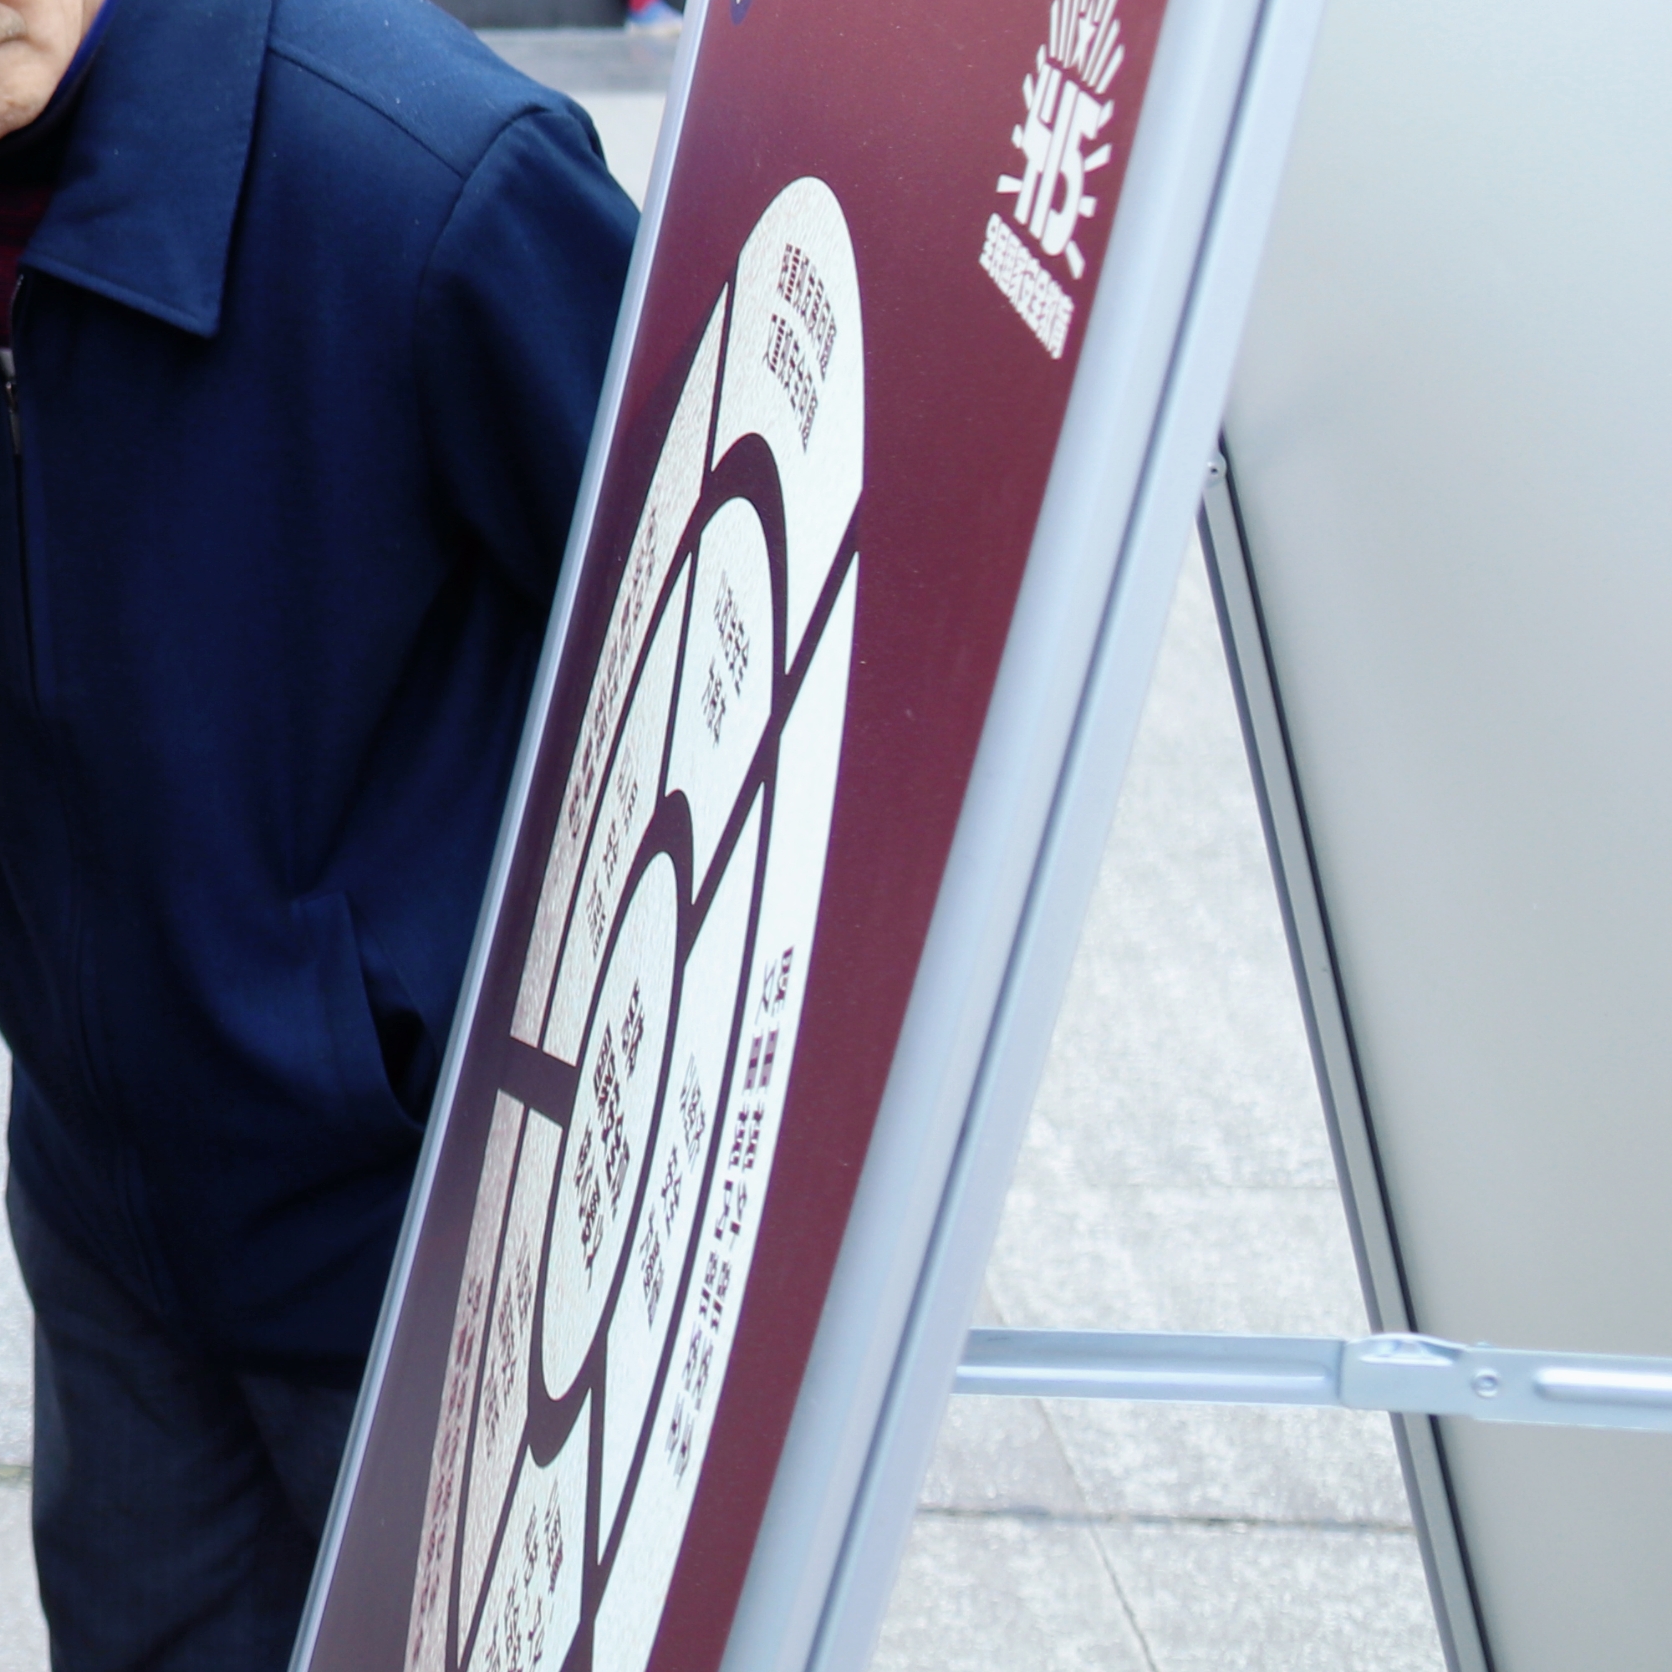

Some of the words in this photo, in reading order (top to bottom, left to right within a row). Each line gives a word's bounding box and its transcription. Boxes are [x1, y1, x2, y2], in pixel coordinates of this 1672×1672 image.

[1015, 60, 1102, 257] 415
[762, 312, 818, 453] 又重视安全问题
[621, 980, 644, 1078] 总体
[593, 1021, 630, 1221] 国家安全观
